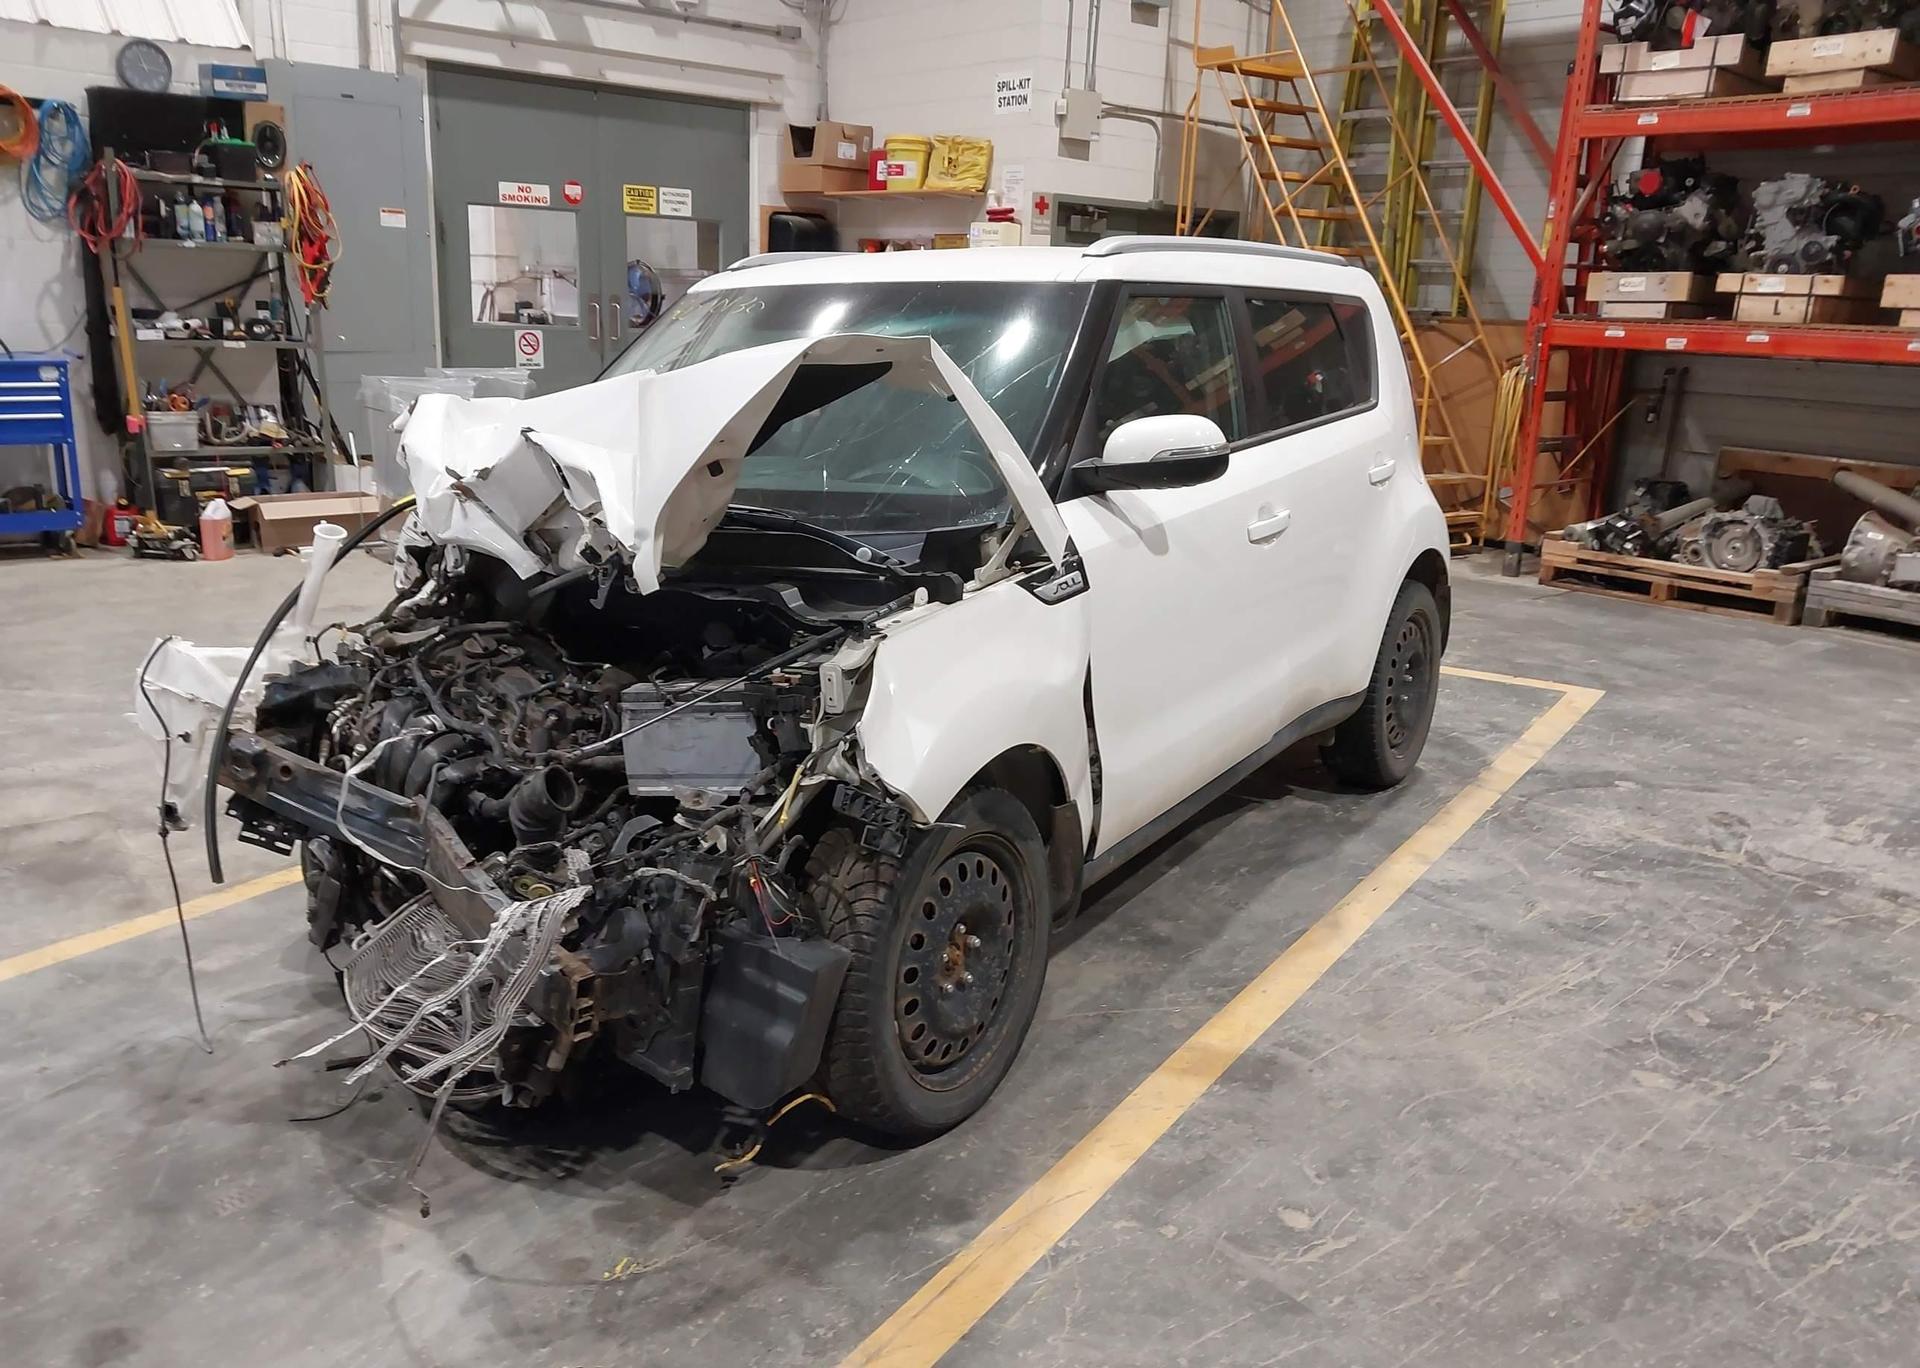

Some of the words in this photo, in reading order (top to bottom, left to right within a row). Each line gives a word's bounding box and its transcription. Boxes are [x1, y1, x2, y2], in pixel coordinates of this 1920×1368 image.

[996, 77, 1031, 92] SPILL-KIT
[997, 93, 1029, 108] STATION
[517, 185, 532, 193] NO
[626, 187, 654, 197] CAUTION
[501, 194, 549, 204] SMOKING
